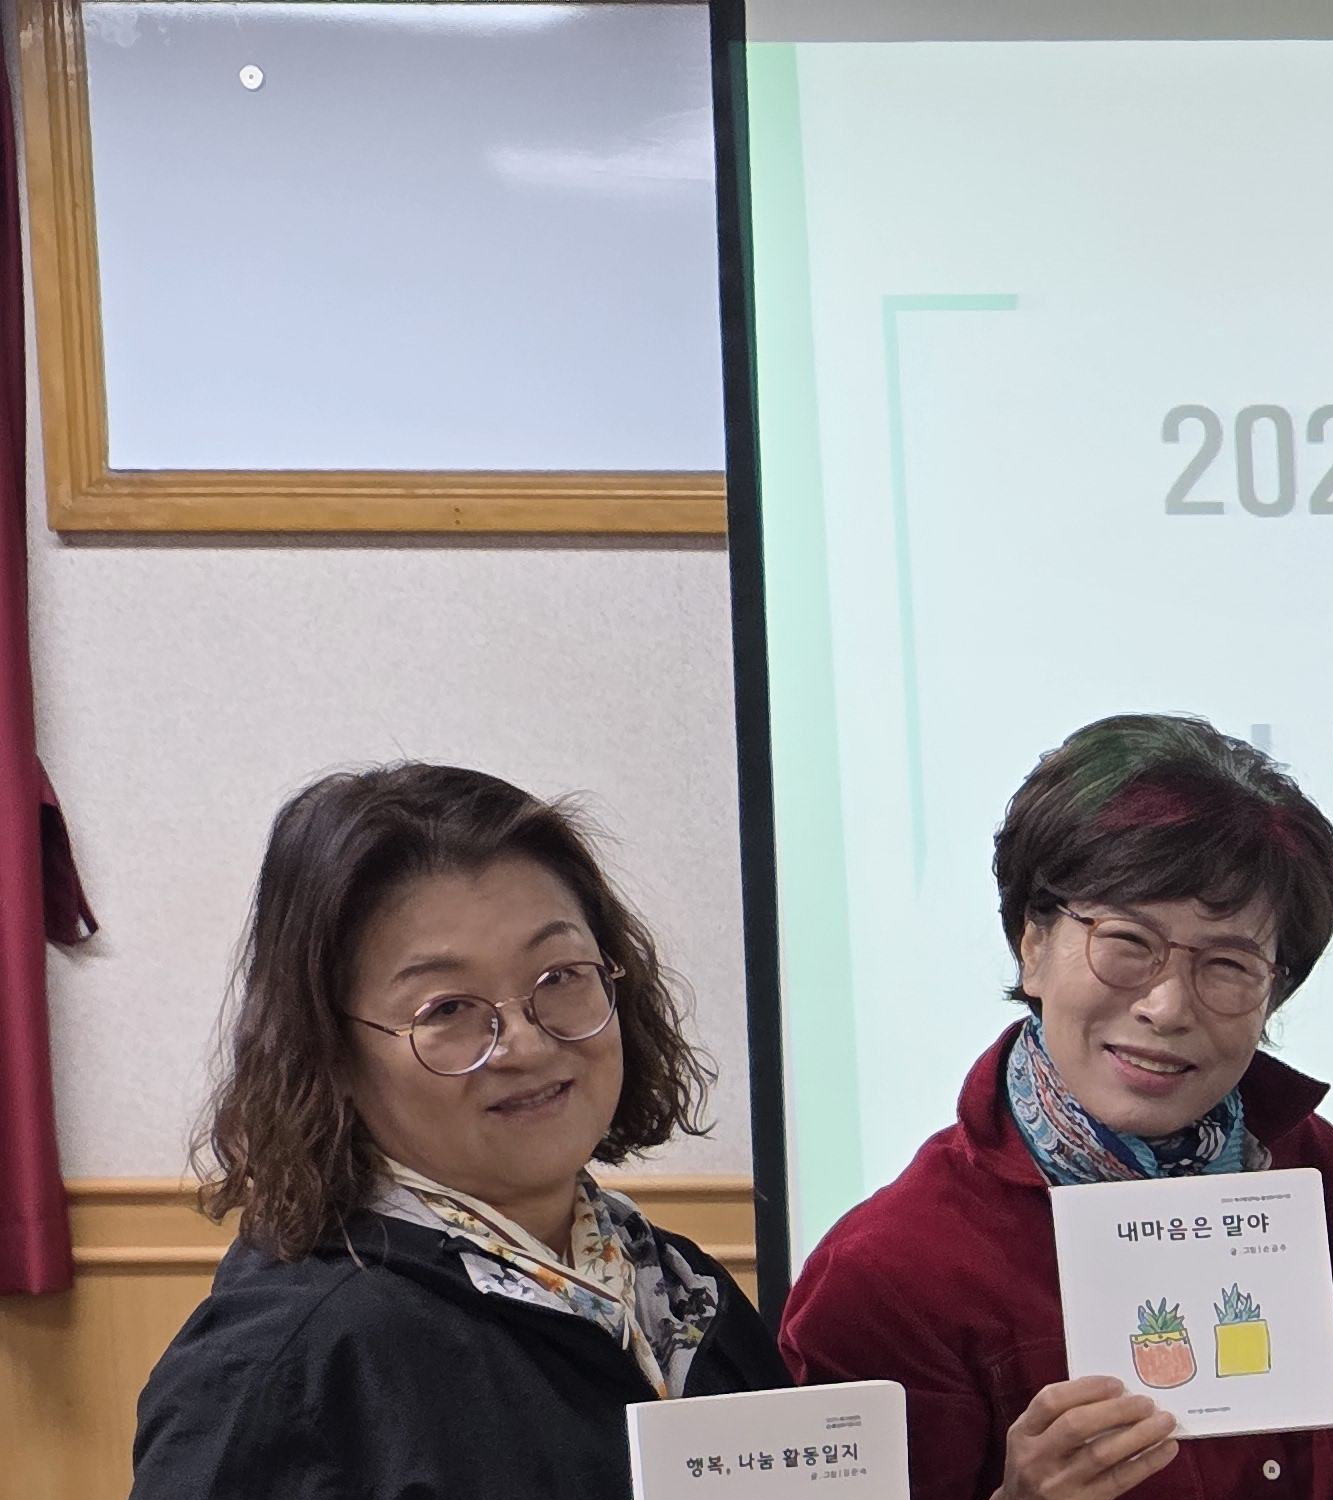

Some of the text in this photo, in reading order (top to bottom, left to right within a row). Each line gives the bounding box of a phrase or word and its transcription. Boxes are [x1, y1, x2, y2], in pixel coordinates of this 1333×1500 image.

[1117, 1212, 1270, 1243] 내마음은 말야
[686, 1443, 860, 1478] 행복, 나눔 활동일지
